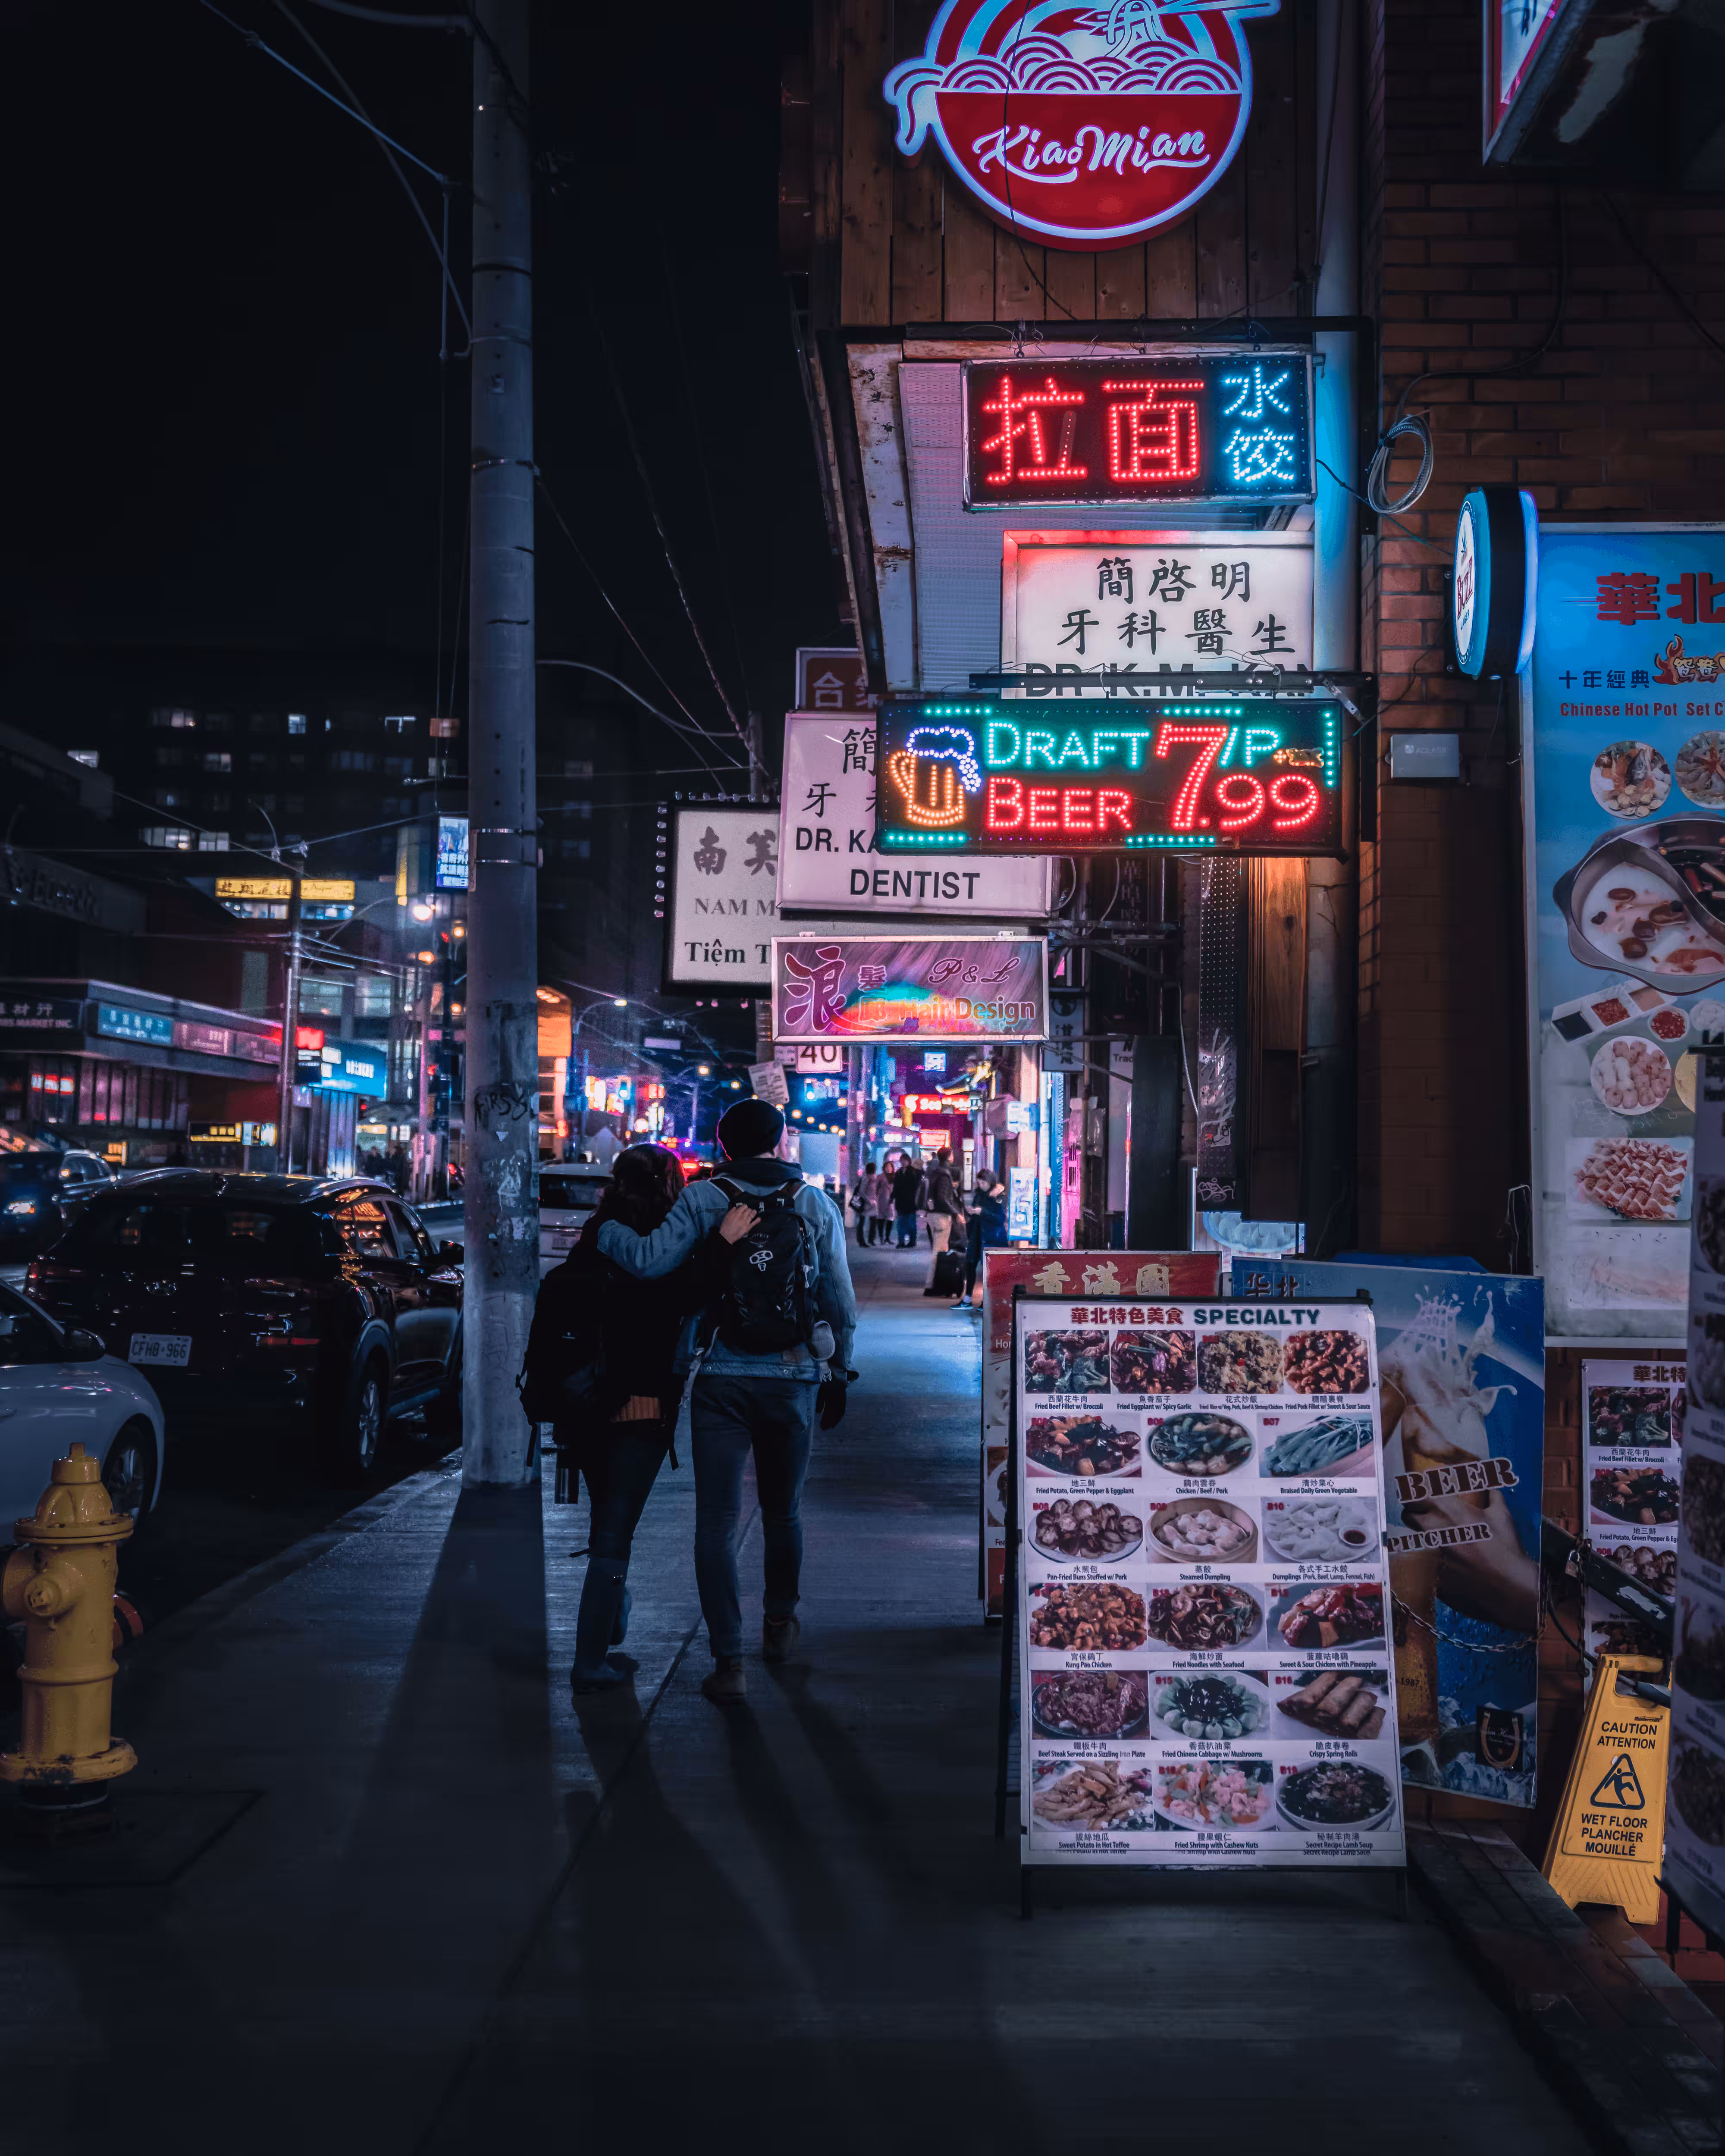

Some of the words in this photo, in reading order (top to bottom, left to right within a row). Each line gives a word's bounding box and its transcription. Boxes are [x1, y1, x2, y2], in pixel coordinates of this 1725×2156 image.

[982, 374, 1204, 486] 拉面
[1596, 572, 1725, 626] 華北
[1057, 608, 1295, 655] 牙科醫生
[1559, 670, 1650, 689] 十年經典
[1560, 702, 1620, 716] Chinese
[1625, 702, 1649, 716] Hot
[1654, 702, 1677, 716] Pot
[1686, 702, 1710, 716] Set
[988, 722, 1150, 767] DRAFT
[1156, 723, 1318, 830] 7.99
[988, 777, 1132, 830] BEER
[796, 827, 839, 853] DR.
[850, 869, 980, 899] DENTIST
[694, 898, 748, 916] NAM
[684, 939, 746, 966] Tiệm
[928, 958, 964, 984] P
[962, 965, 979, 984] &
[954, 996, 1036, 1026] Design
[800, 1045, 837, 1064] 40
[1071, 1307, 1184, 1325] 華北特色美食
[1194, 1309, 1320, 1326] SPECIALTY
[166, 1343, 187, 1358] 966
[1131, 1403, 1154, 1411] Eggplant
[1395, 1457, 1519, 1504] BEER
[1387, 1522, 1493, 1553] PITCHER
[1601, 1721, 1657, 1736] CAUTION
[1597, 1736, 1656, 1749] ATTENTION
[1581, 1813, 1606, 1826] WET
[1609, 1815, 1648, 1829] FLOOR
[1581, 1827, 1643, 1843] PLANCHER
[1585, 1842, 1637, 1856] MOUILLÉ
